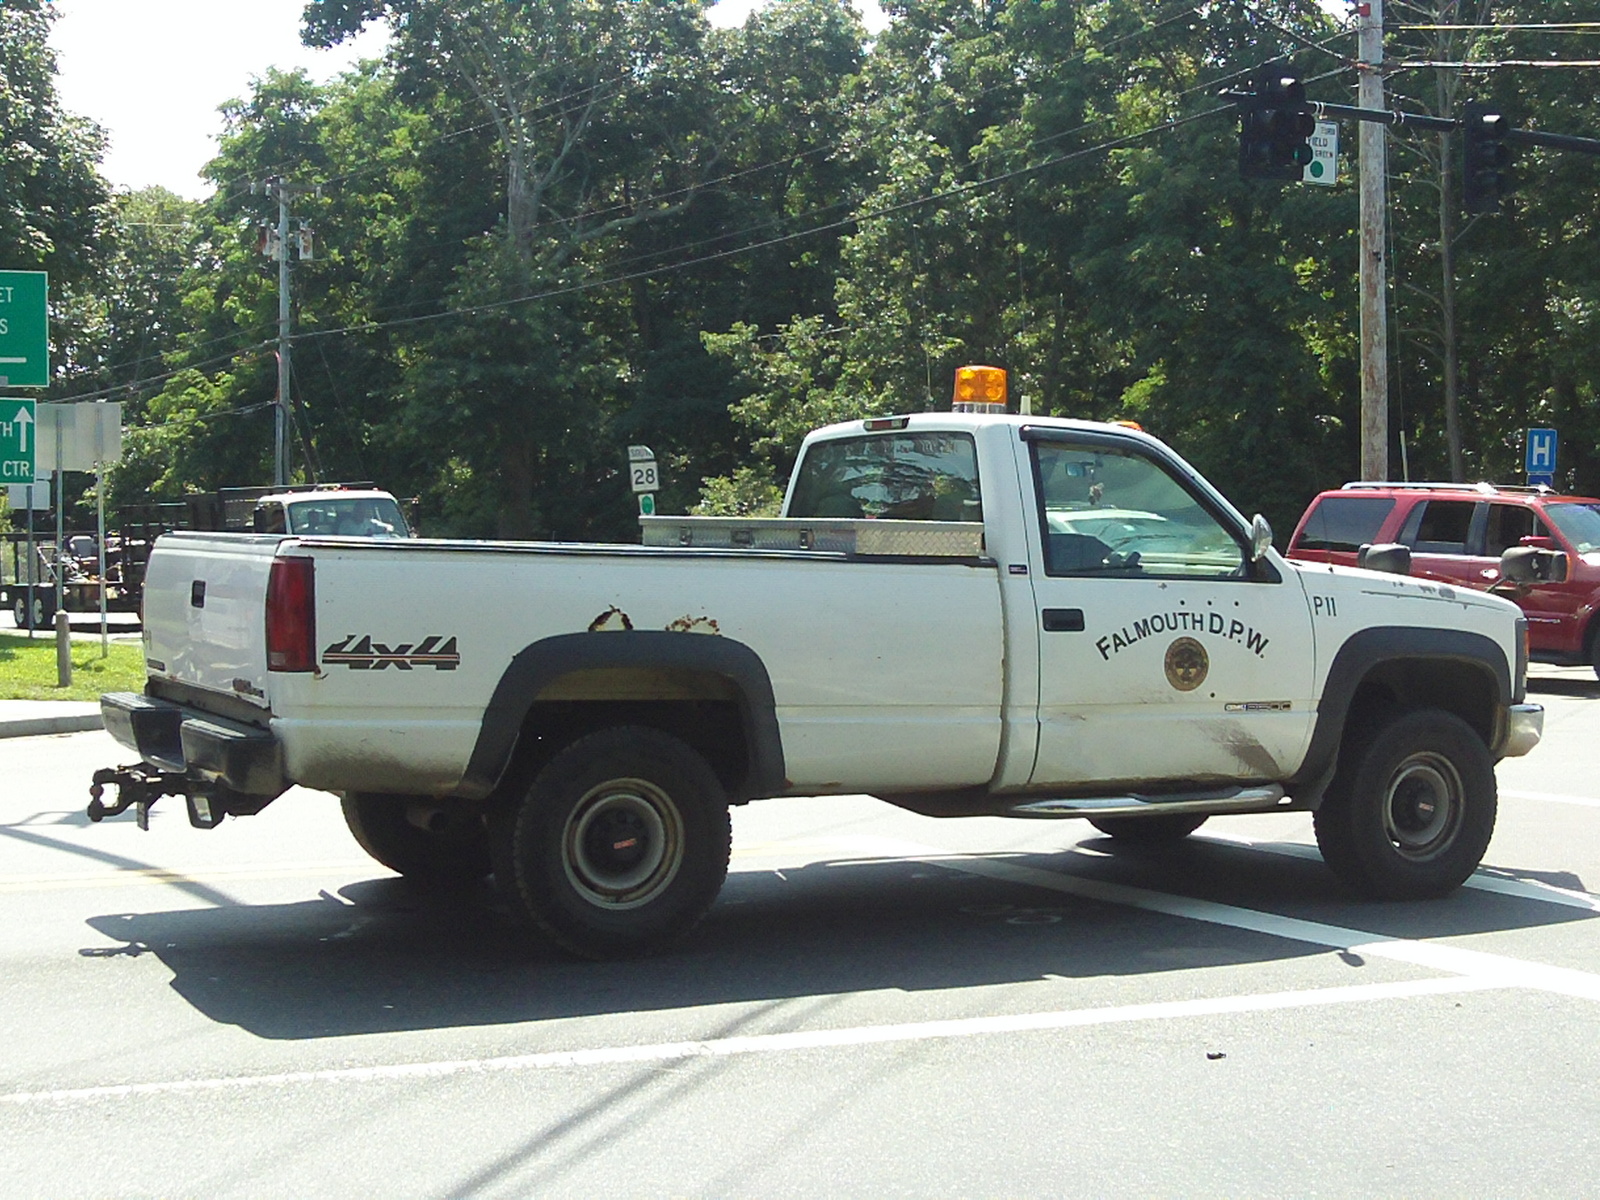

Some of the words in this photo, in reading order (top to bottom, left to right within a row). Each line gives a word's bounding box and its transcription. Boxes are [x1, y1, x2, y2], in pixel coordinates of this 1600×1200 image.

[1532, 435, 1551, 466] H
[3, 460, 34, 477] CTR.
[633, 468, 656, 485] 28
[1095, 612, 1204, 660] FALMOUTH
[1209, 612, 1269, 659] D.P.W.
